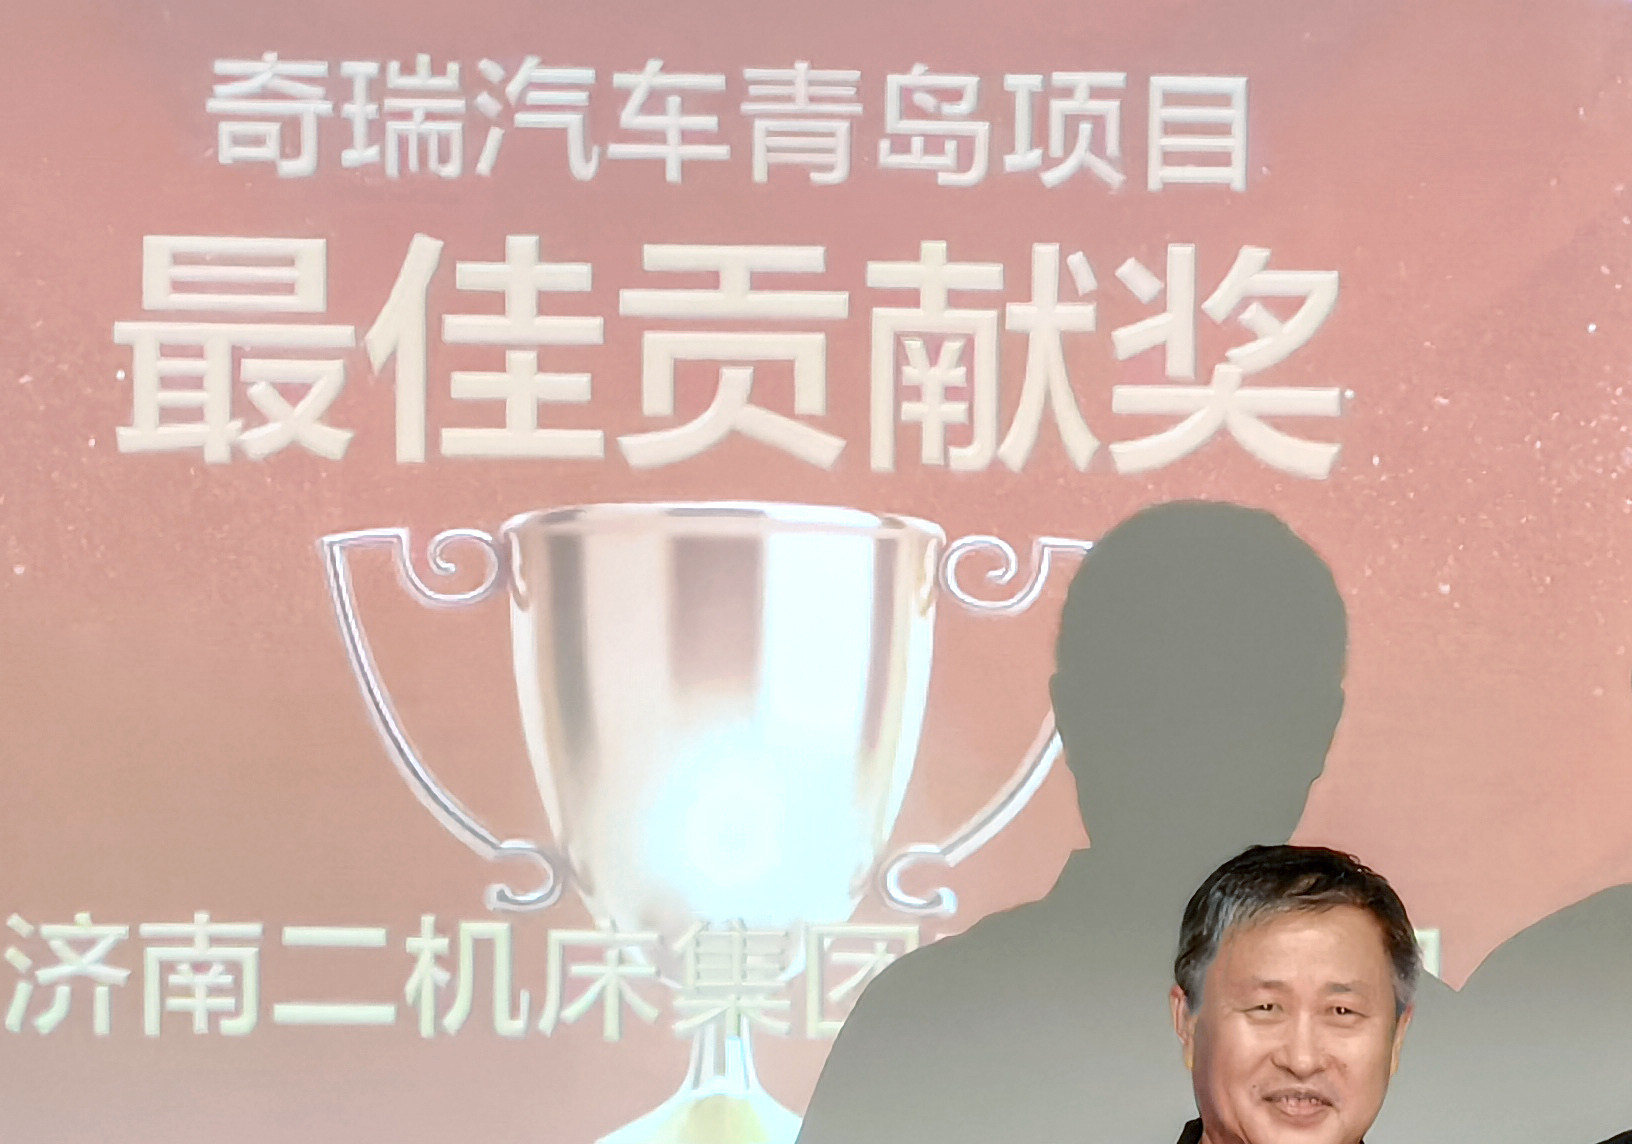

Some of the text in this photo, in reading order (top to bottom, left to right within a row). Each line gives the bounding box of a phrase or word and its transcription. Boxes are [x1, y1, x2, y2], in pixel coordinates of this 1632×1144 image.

[204, 50, 1250, 192] 奇瑞汽车青岛项目
[112, 231, 1343, 480] 最佳贡献奖
